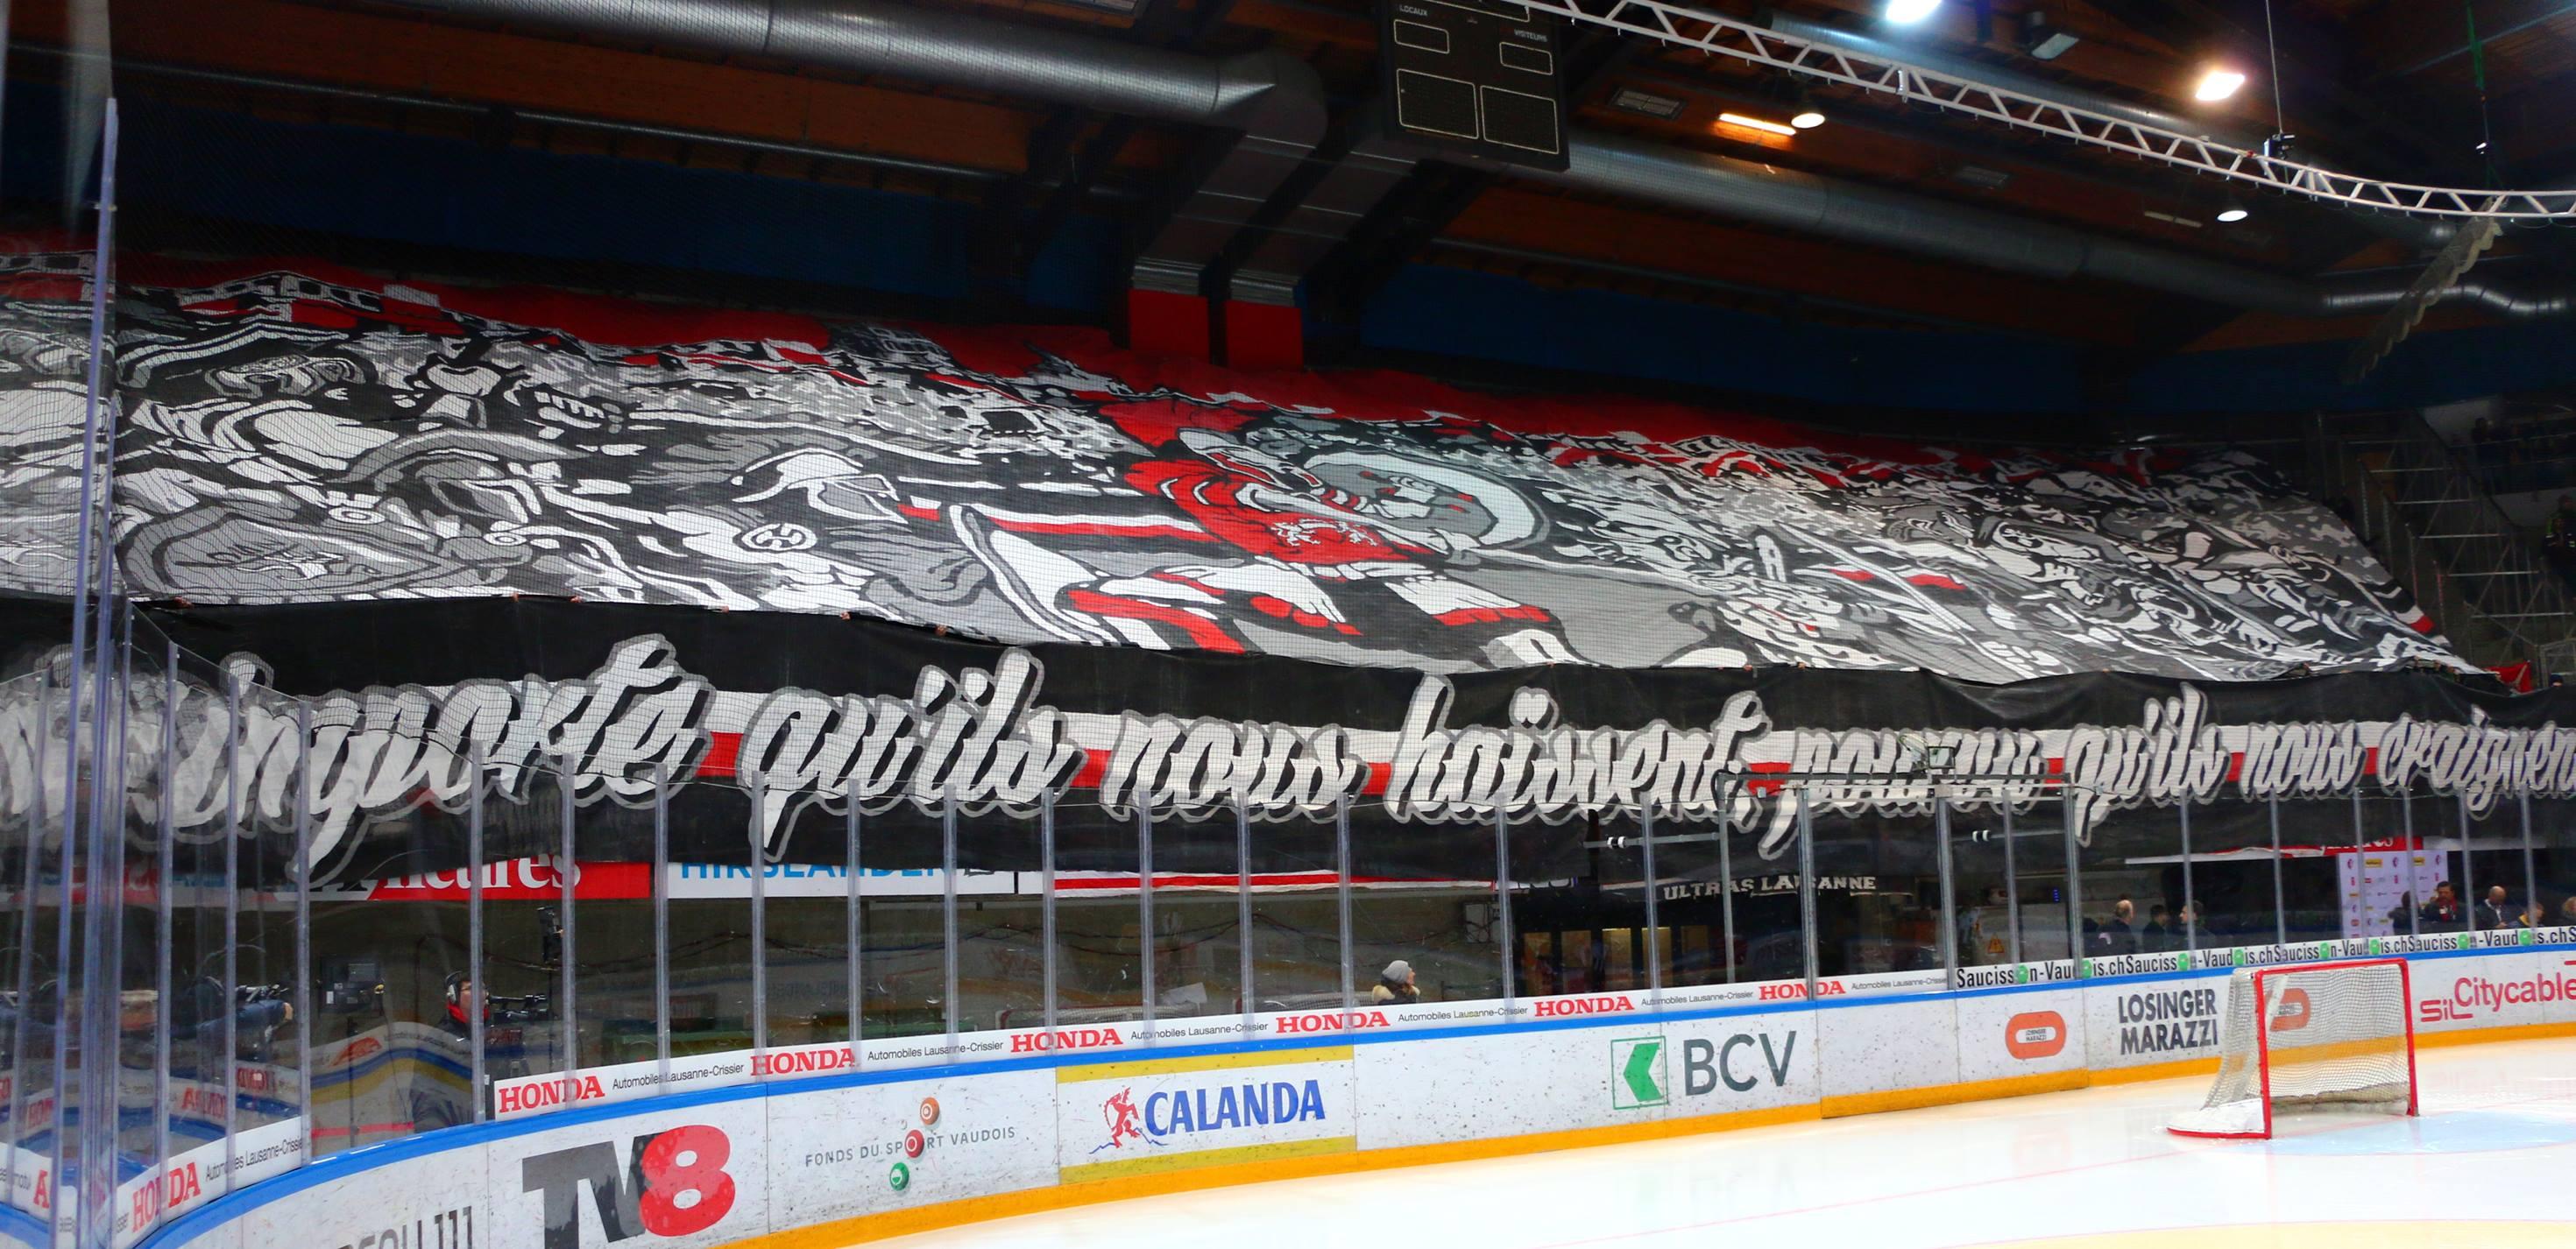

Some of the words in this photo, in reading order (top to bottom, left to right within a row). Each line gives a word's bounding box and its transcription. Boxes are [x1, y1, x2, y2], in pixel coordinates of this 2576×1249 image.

[738, 646, 1088, 863] qu'ils
[1100, 708, 1370, 823] nous
[2063, 681, 2232, 847] qu'ils
[2239, 719, 2367, 801] nous
[1663, 879, 1754, 900] ULTRAS
[1760, 874, 1878, 891] LAANNE
[2118, 988, 2218, 1024] LOSINGER
[2454, 971, 2576, 1013] Citycable
[499, 1076, 605, 1113] HONDA
[612, 1074, 662, 1090] Automobiles
[664, 1063, 745, 1083] Lausanne-Crissier
[750, 1048, 856, 1076] HONDA
[867, 1048, 922, 1062] Automobiles
[924, 1041, 1003, 1056] Lausanne-Crissier
[1010, 1028, 1123, 1053] HONDA
[1131, 1028, 1185, 1041] Automobiles
[1188, 1022, 1269, 1035] Lausanne-Crissier
[1276, 1012, 1391, 1034] HONDA
[1398, 1009, 1451, 1022] Automobiles
[1454, 1006, 1528, 1019] Lausanne-Crissier
[1534, 996, 1635, 1017] HONDA
[1641, 994, 1688, 1006] Automobiles
[1688, 991, 1753, 1003] Lausanne-Crissier
[1759, 980, 1846, 1001] HONDA
[1851, 978, 1892, 991] Automobiles
[1893, 976, 1948, 988] Lausanne-Crissie
[2120, 1019, 2219, 1055] MARAZZI
[1683, 1031, 1797, 1096] BCV
[1144, 1080, 1326, 1136] CALANDA
[246, 1136, 302, 1167] Lausanne-Crissie
[805, 1148, 853, 1168] FONDS
[860, 1146, 880, 1159] DU
[951, 1126, 1016, 1146] VAUDOIS
[521, 1125, 735, 1249] TV8
